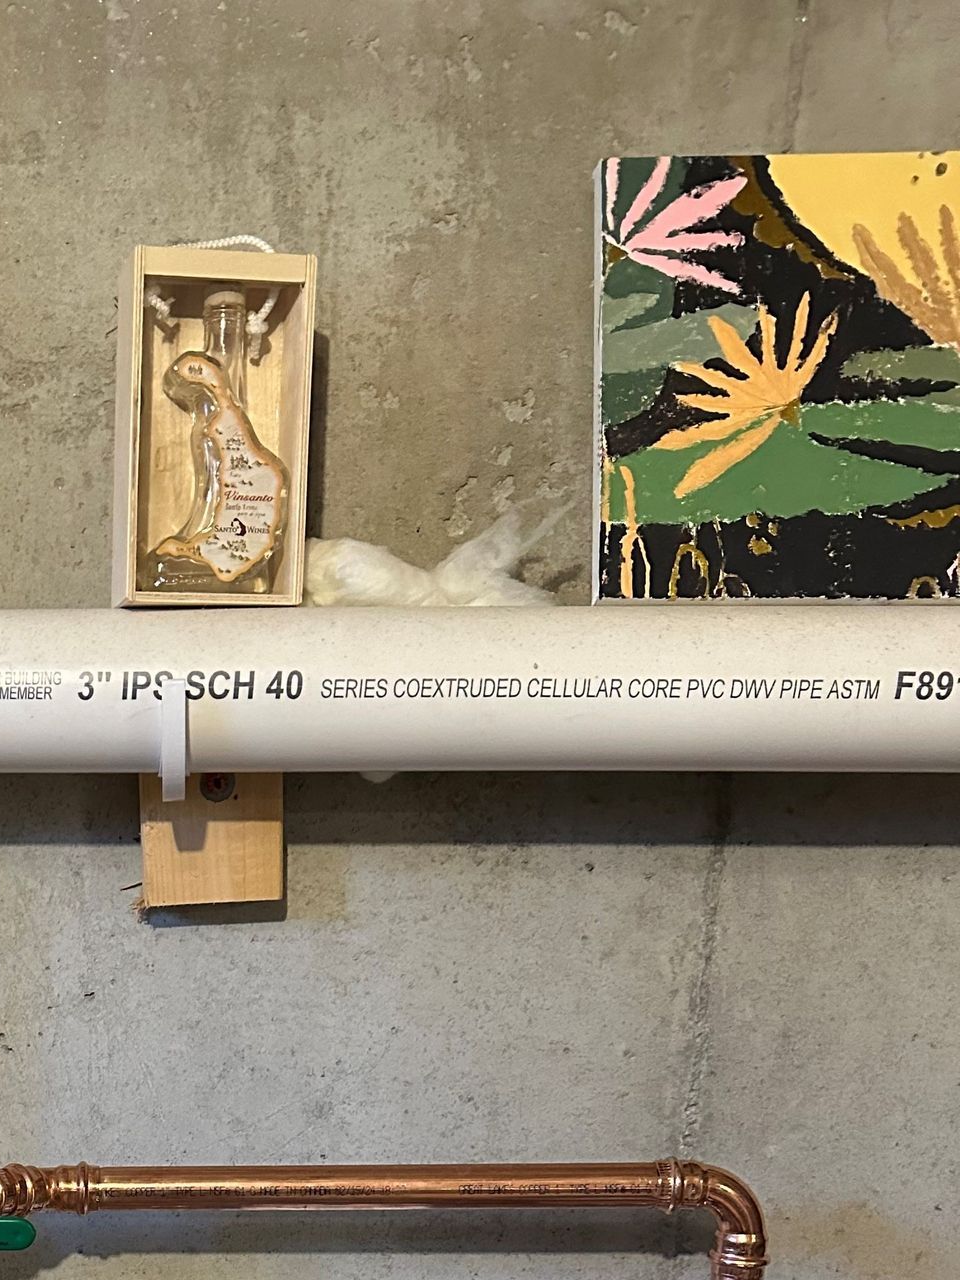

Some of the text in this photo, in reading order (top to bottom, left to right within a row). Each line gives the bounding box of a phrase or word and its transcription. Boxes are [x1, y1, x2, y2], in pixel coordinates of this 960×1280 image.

[224, 490, 274, 502] Vinsanto
[77, 671, 112, 700] 3"
[185, 670, 256, 700] SCH
[265, 670, 304, 700] 40
[320, 678, 389, 700] SERIES
[393, 678, 522, 700] COEXTRUDED
[527, 678, 622, 700] CELLULAR
[627, 678, 682, 700] CORE
[686, 678, 726, 700] PVC
[730, 678, 775, 700] DWV
[780, 678, 822, 700] PIPE
[826, 678, 881, 700] ASTM
[894, 671, 960, 700] F89
